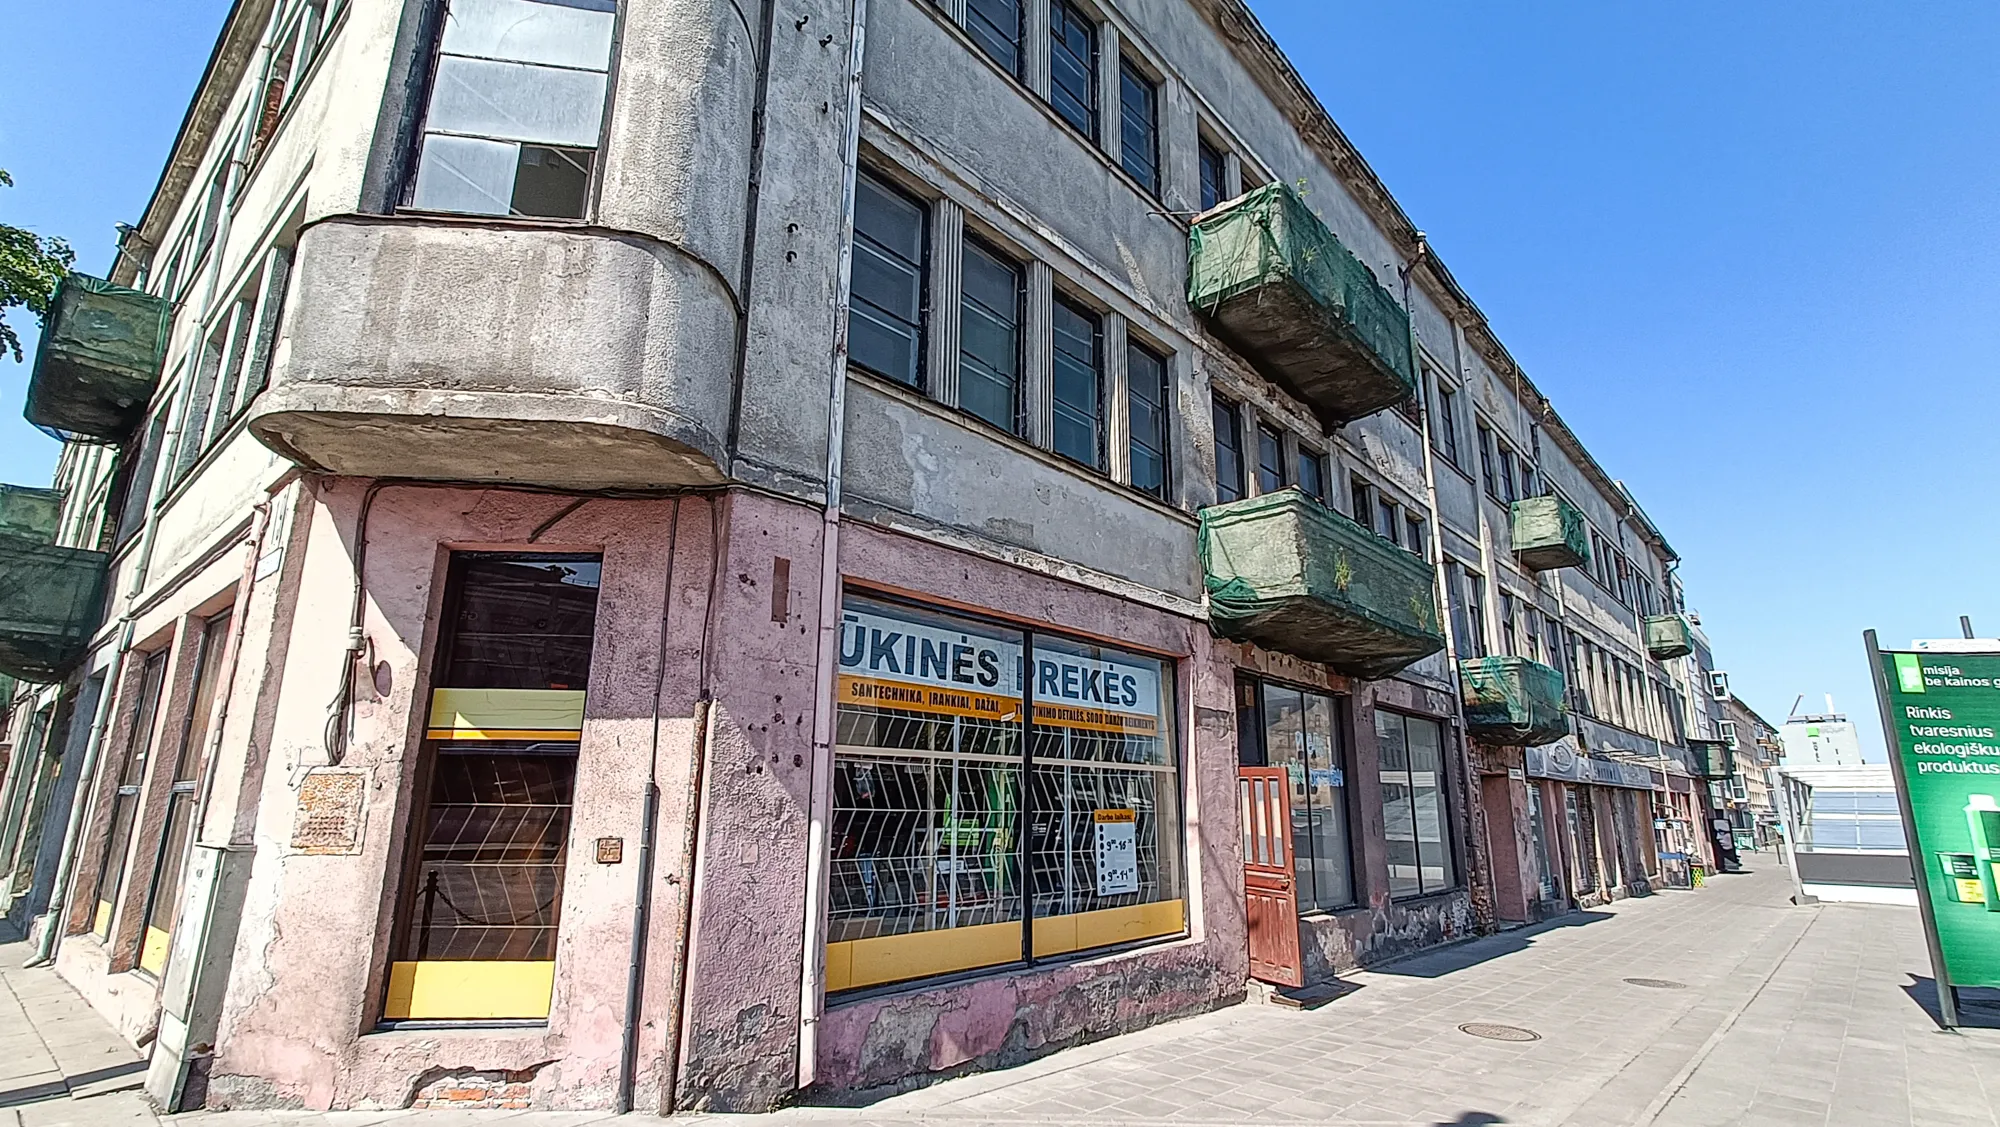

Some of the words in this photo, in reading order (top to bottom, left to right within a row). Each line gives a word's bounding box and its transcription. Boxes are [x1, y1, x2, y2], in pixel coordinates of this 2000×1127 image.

[840, 614, 999, 687] ŪKINĖS
[1923, 666, 1960, 677] misija
[1925, 678, 1942, 687] be
[1945, 678, 1990, 687] kainos
[851, 682, 925, 705] SANTECHNIKA,
[929, 692, 972, 711] ĮRANKIAI,
[975, 696, 1001, 714] DAŽAI,
[1905, 706, 1952, 720] Rinkis
[1910, 725, 1994, 738] tvaresnius
[1914, 742, 2000, 757] ekologišku
